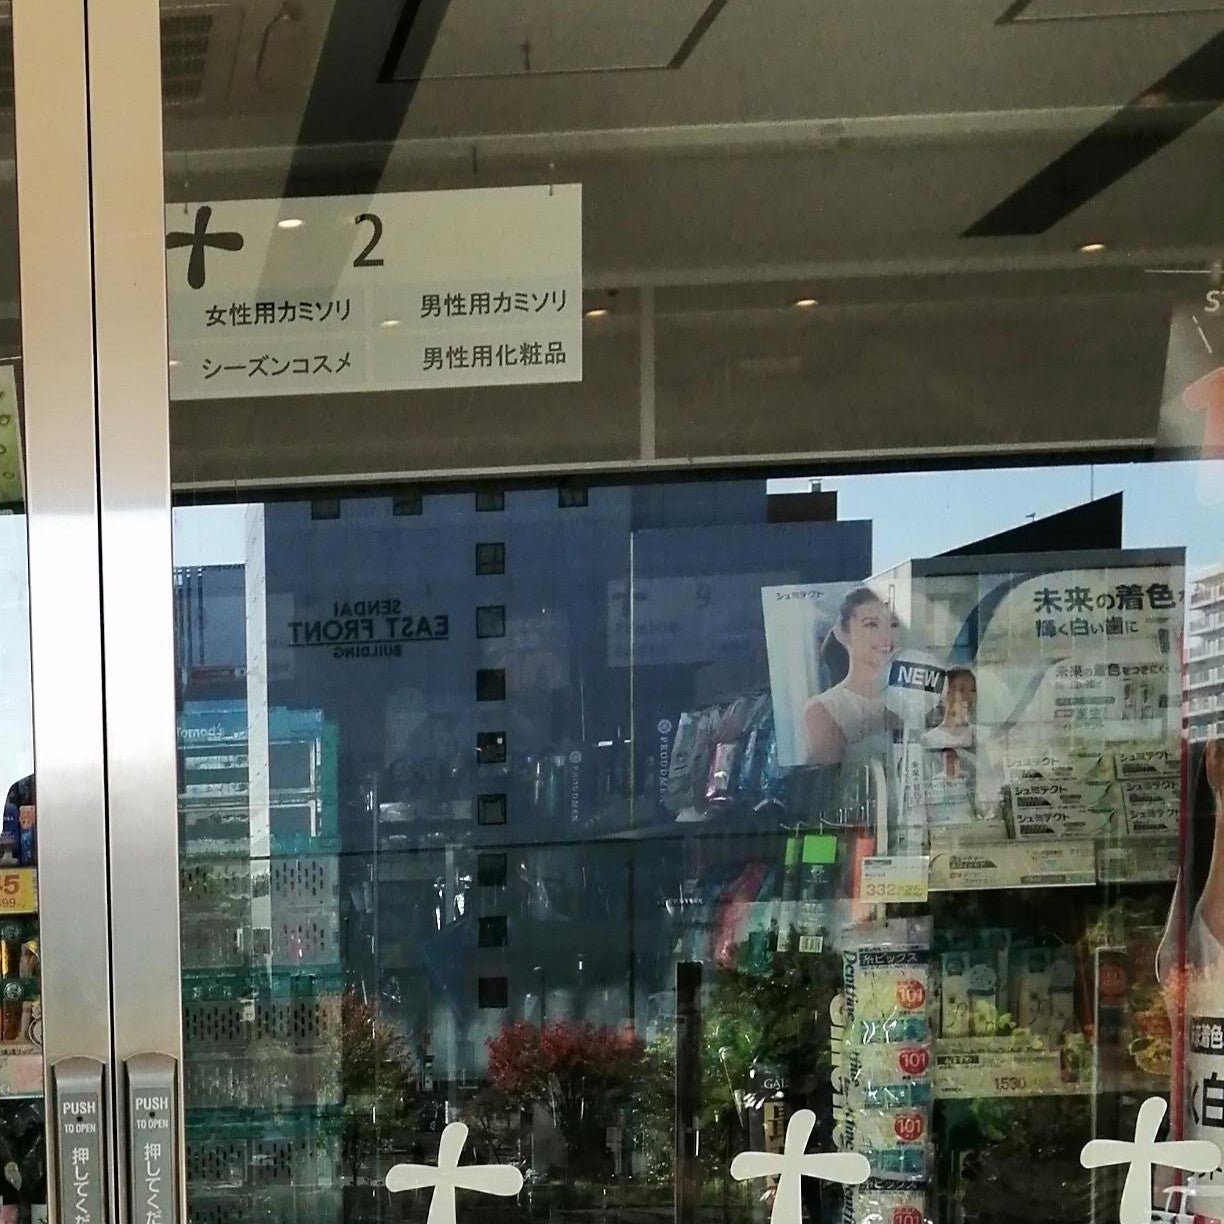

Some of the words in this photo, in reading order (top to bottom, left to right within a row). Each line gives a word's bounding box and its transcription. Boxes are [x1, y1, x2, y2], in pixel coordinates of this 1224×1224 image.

[353, 212, 385, 268] 2
[419, 289, 568, 319] 男性用カミソリ
[206, 299, 353, 328] 女性用カミソリ
[422, 341, 567, 371] 男性用化粧品
[202, 350, 353, 380] シーズンコスメ
[897, 665, 942, 689] NEW
[898, 985, 924, 1001] 101
[902, 1053, 926, 1068] 101
[63, 1101, 96, 1115] PUSH
[135, 1096, 169, 1111] PUSH
[64, 1124, 75, 1134] TO
[76, 1123, 96, 1134] OPEN
[136, 1119, 147, 1130] TO
[148, 1118, 169, 1130] OPEN
[897, 1120, 923, 1134] 101
